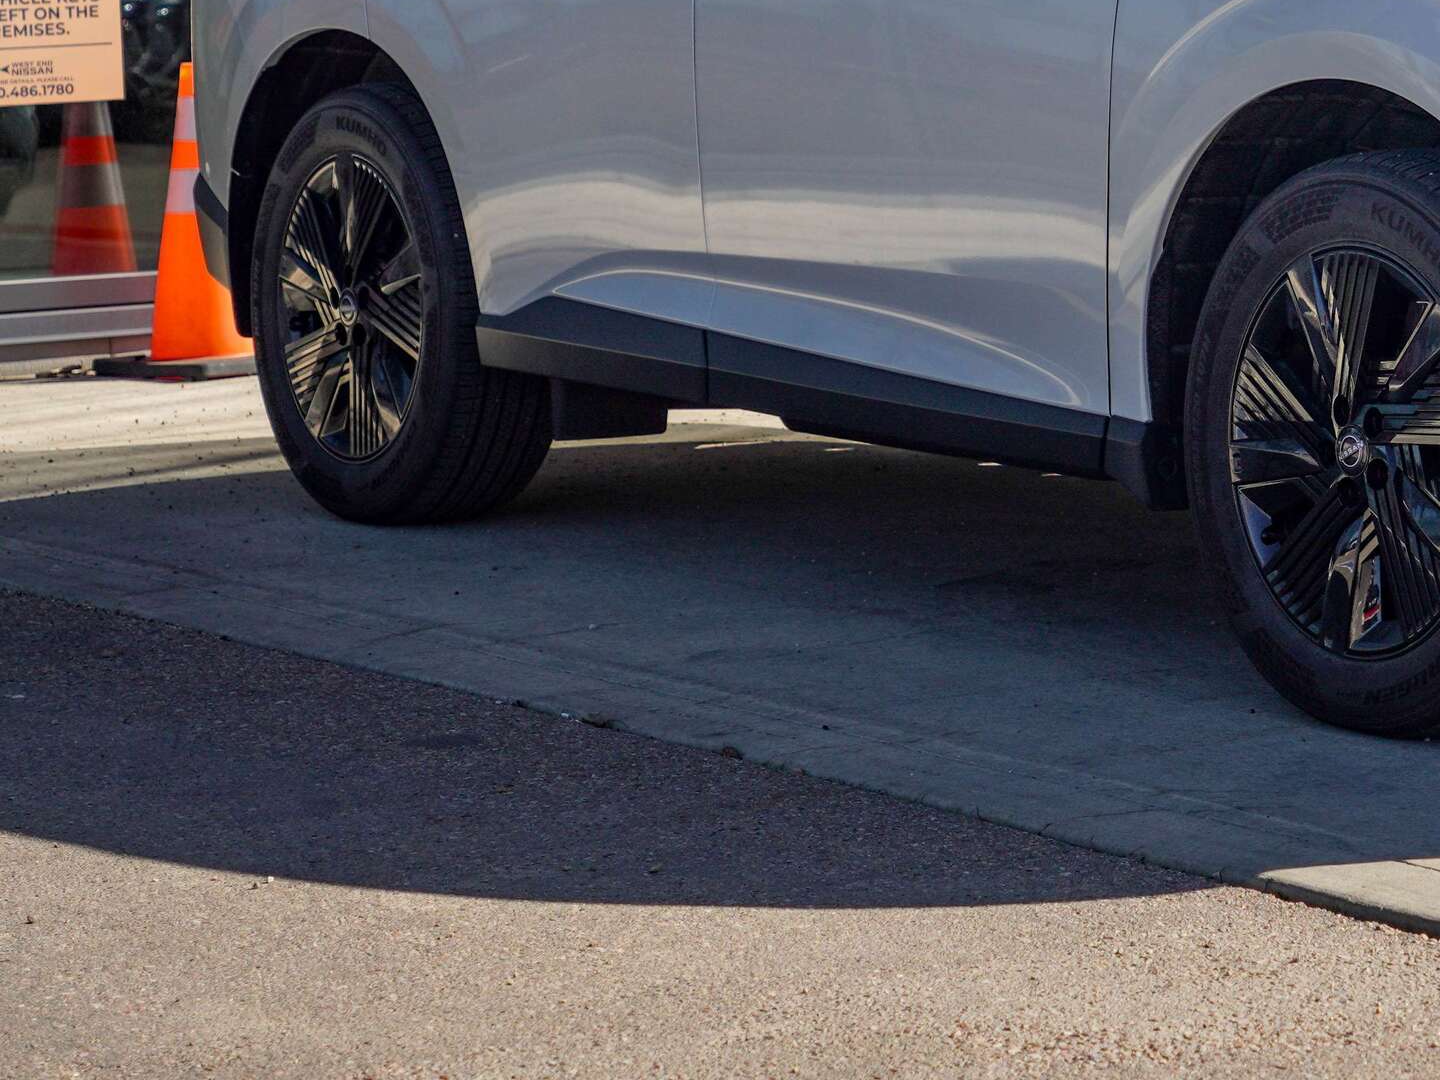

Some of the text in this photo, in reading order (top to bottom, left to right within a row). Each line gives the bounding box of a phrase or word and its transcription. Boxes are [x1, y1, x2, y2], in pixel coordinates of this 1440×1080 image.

[0, 5, 99, 22] EFT ON THE
[0, 22, 70, 37] EMISES.
[11, 66, 54, 76] NISSAN
[335, 115, 387, 157] KUMHO
